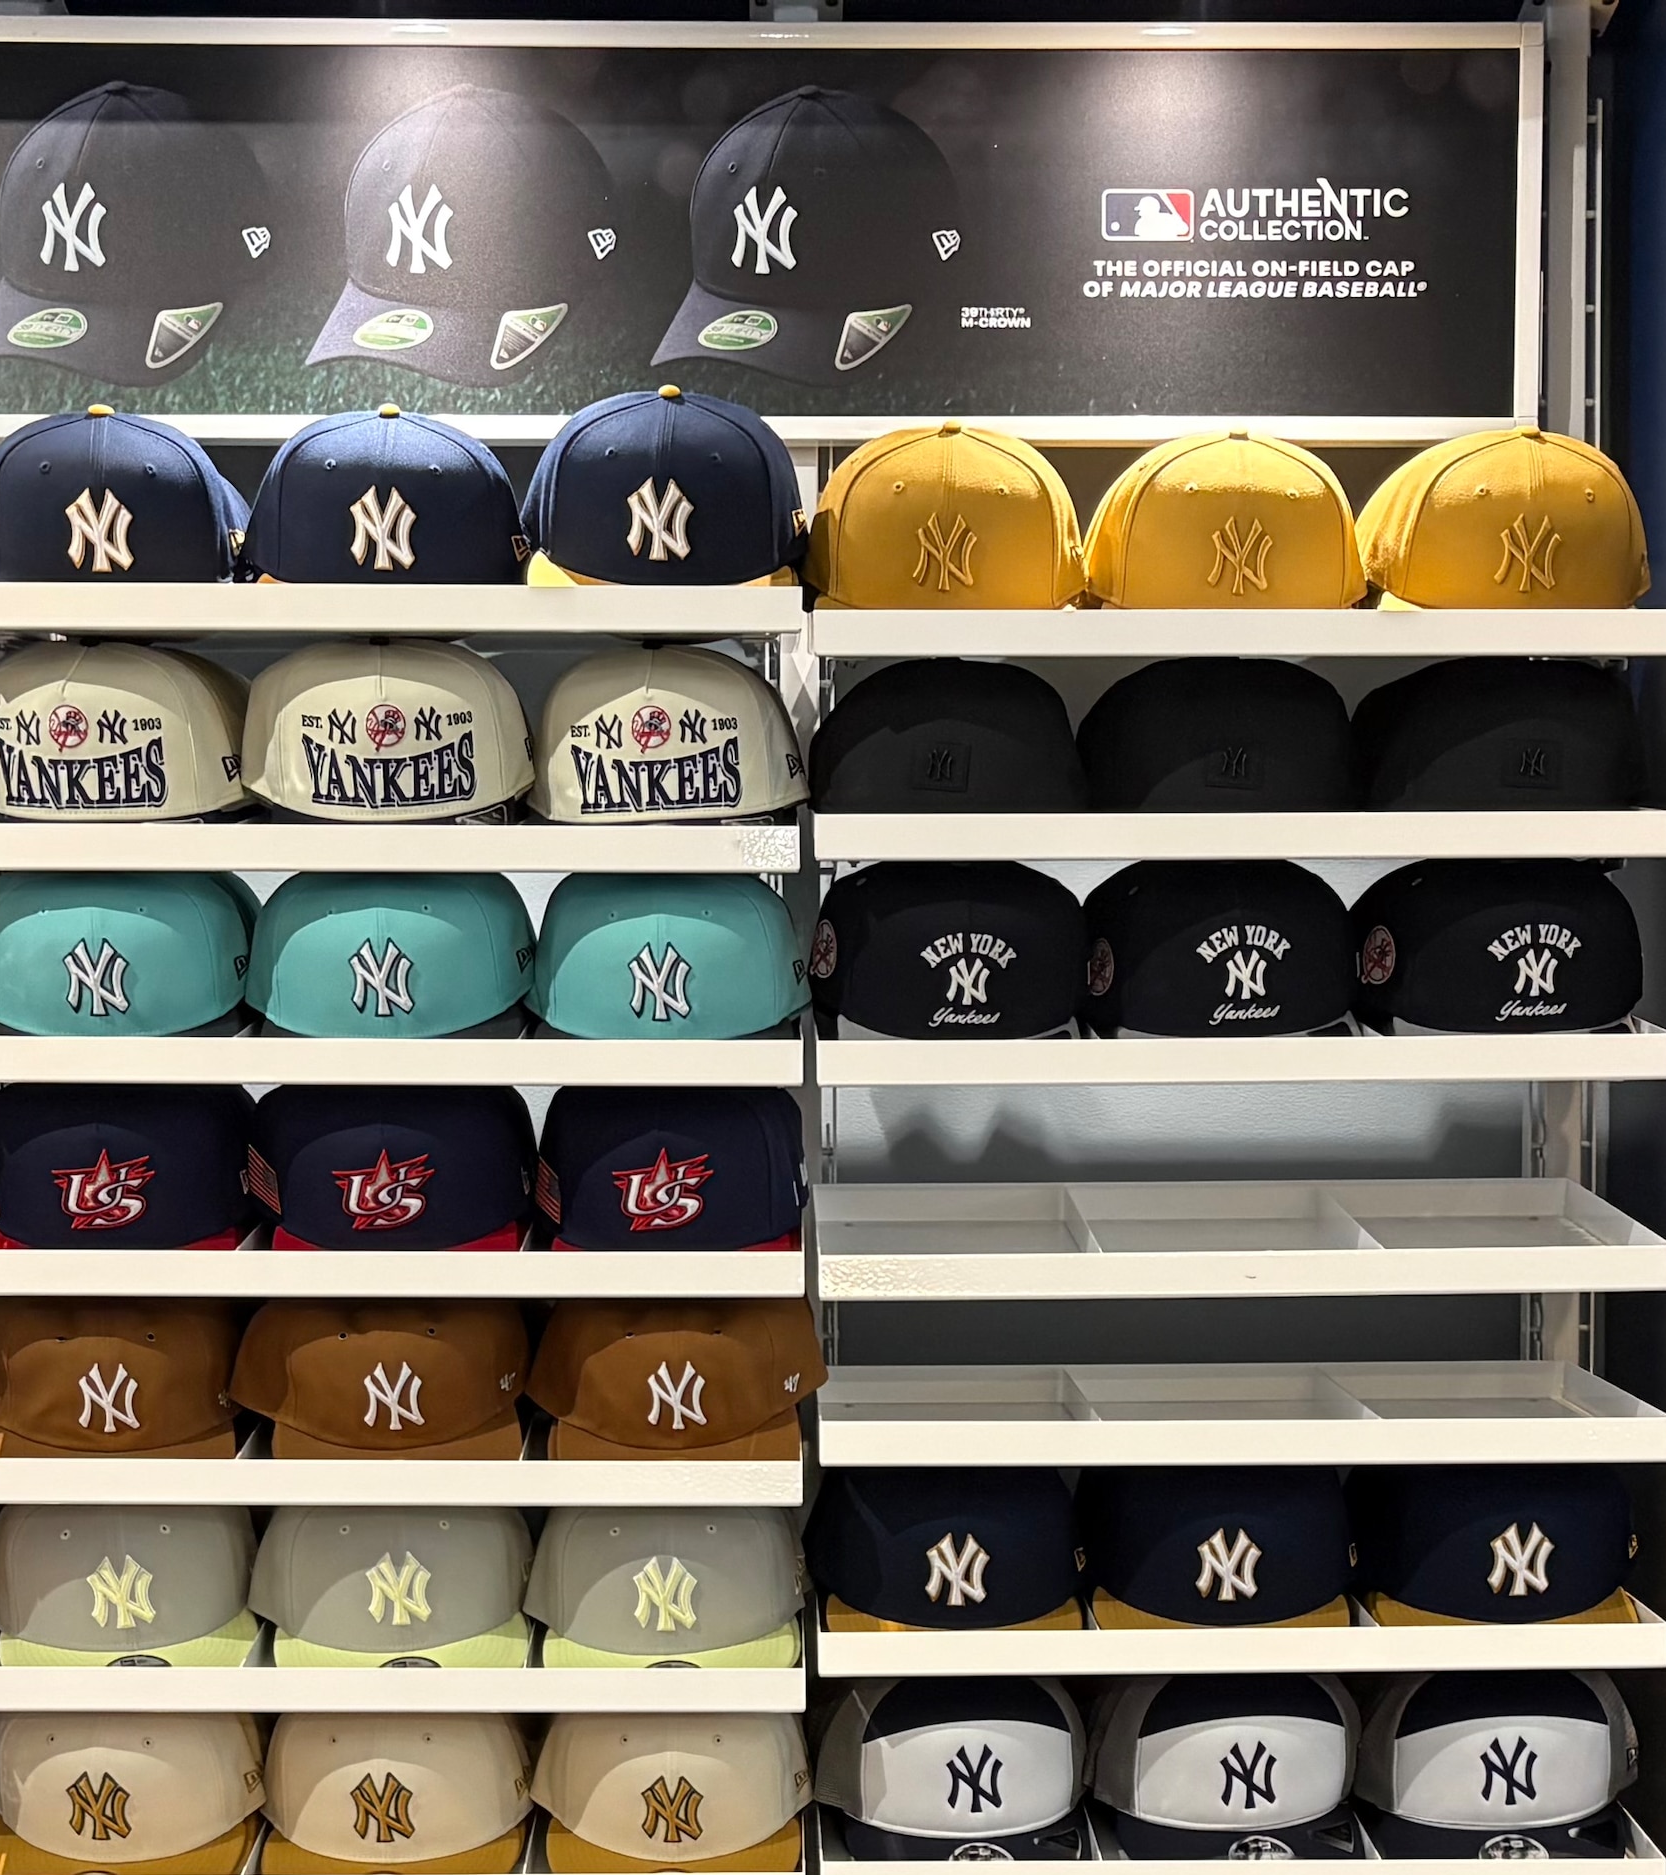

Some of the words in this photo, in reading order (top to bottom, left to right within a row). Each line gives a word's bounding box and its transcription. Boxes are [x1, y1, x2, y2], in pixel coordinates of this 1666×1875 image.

[40, 182, 106, 271] NY
[386, 184, 453, 273] NY
[731, 186, 798, 274] NY
[1200, 178, 1410, 219] AUTHENTIC
[1083, 281, 1114, 298] OF
[1119, 281, 1201, 299] MAJOR
[1206, 281, 1297, 299] LEAGUE
[1093, 260, 1137, 277] THE
[1143, 260, 1247, 277] OFFICIAL
[1251, 260, 1360, 277] ON-FIELD
[1365, 260, 1415, 277] CAP
[348, 485, 414, 571] NY
[625, 475, 695, 562] NY
[1208, 514, 1274, 596] NY
[16, 709, 41, 745] NY
[96, 709, 128, 745] NY
[595, 713, 623, 750] NY
[678, 709, 708, 744] NY
[571, 736, 743, 814] YANKEES
[348, 936, 414, 1018] NY
[920, 932, 964, 969] NEW
[969, 932, 1018, 969] YORK
[1486, 924, 1535, 962] NEW
[1537, 923, 1583, 960] YORK
[1514, 946, 1559, 997] NY
[928, 1006, 1001, 1028] Yankees
[946, 957, 991, 1006] NY
[1494, 998, 1568, 1023] Yankees
[363, 1359, 425, 1432] NY
[647, 1359, 707, 1432] NY
[85, 1552, 157, 1631] NY
[365, 1550, 432, 1626] NY
[925, 1531, 990, 1606] NY
[1487, 1521, 1555, 1597] NY
[67, 1770, 133, 1841] NY
[1219, 1739, 1277, 1810] NY
[1480, 1736, 1538, 1806] NY
[639, 1775, 705, 1844] NY
